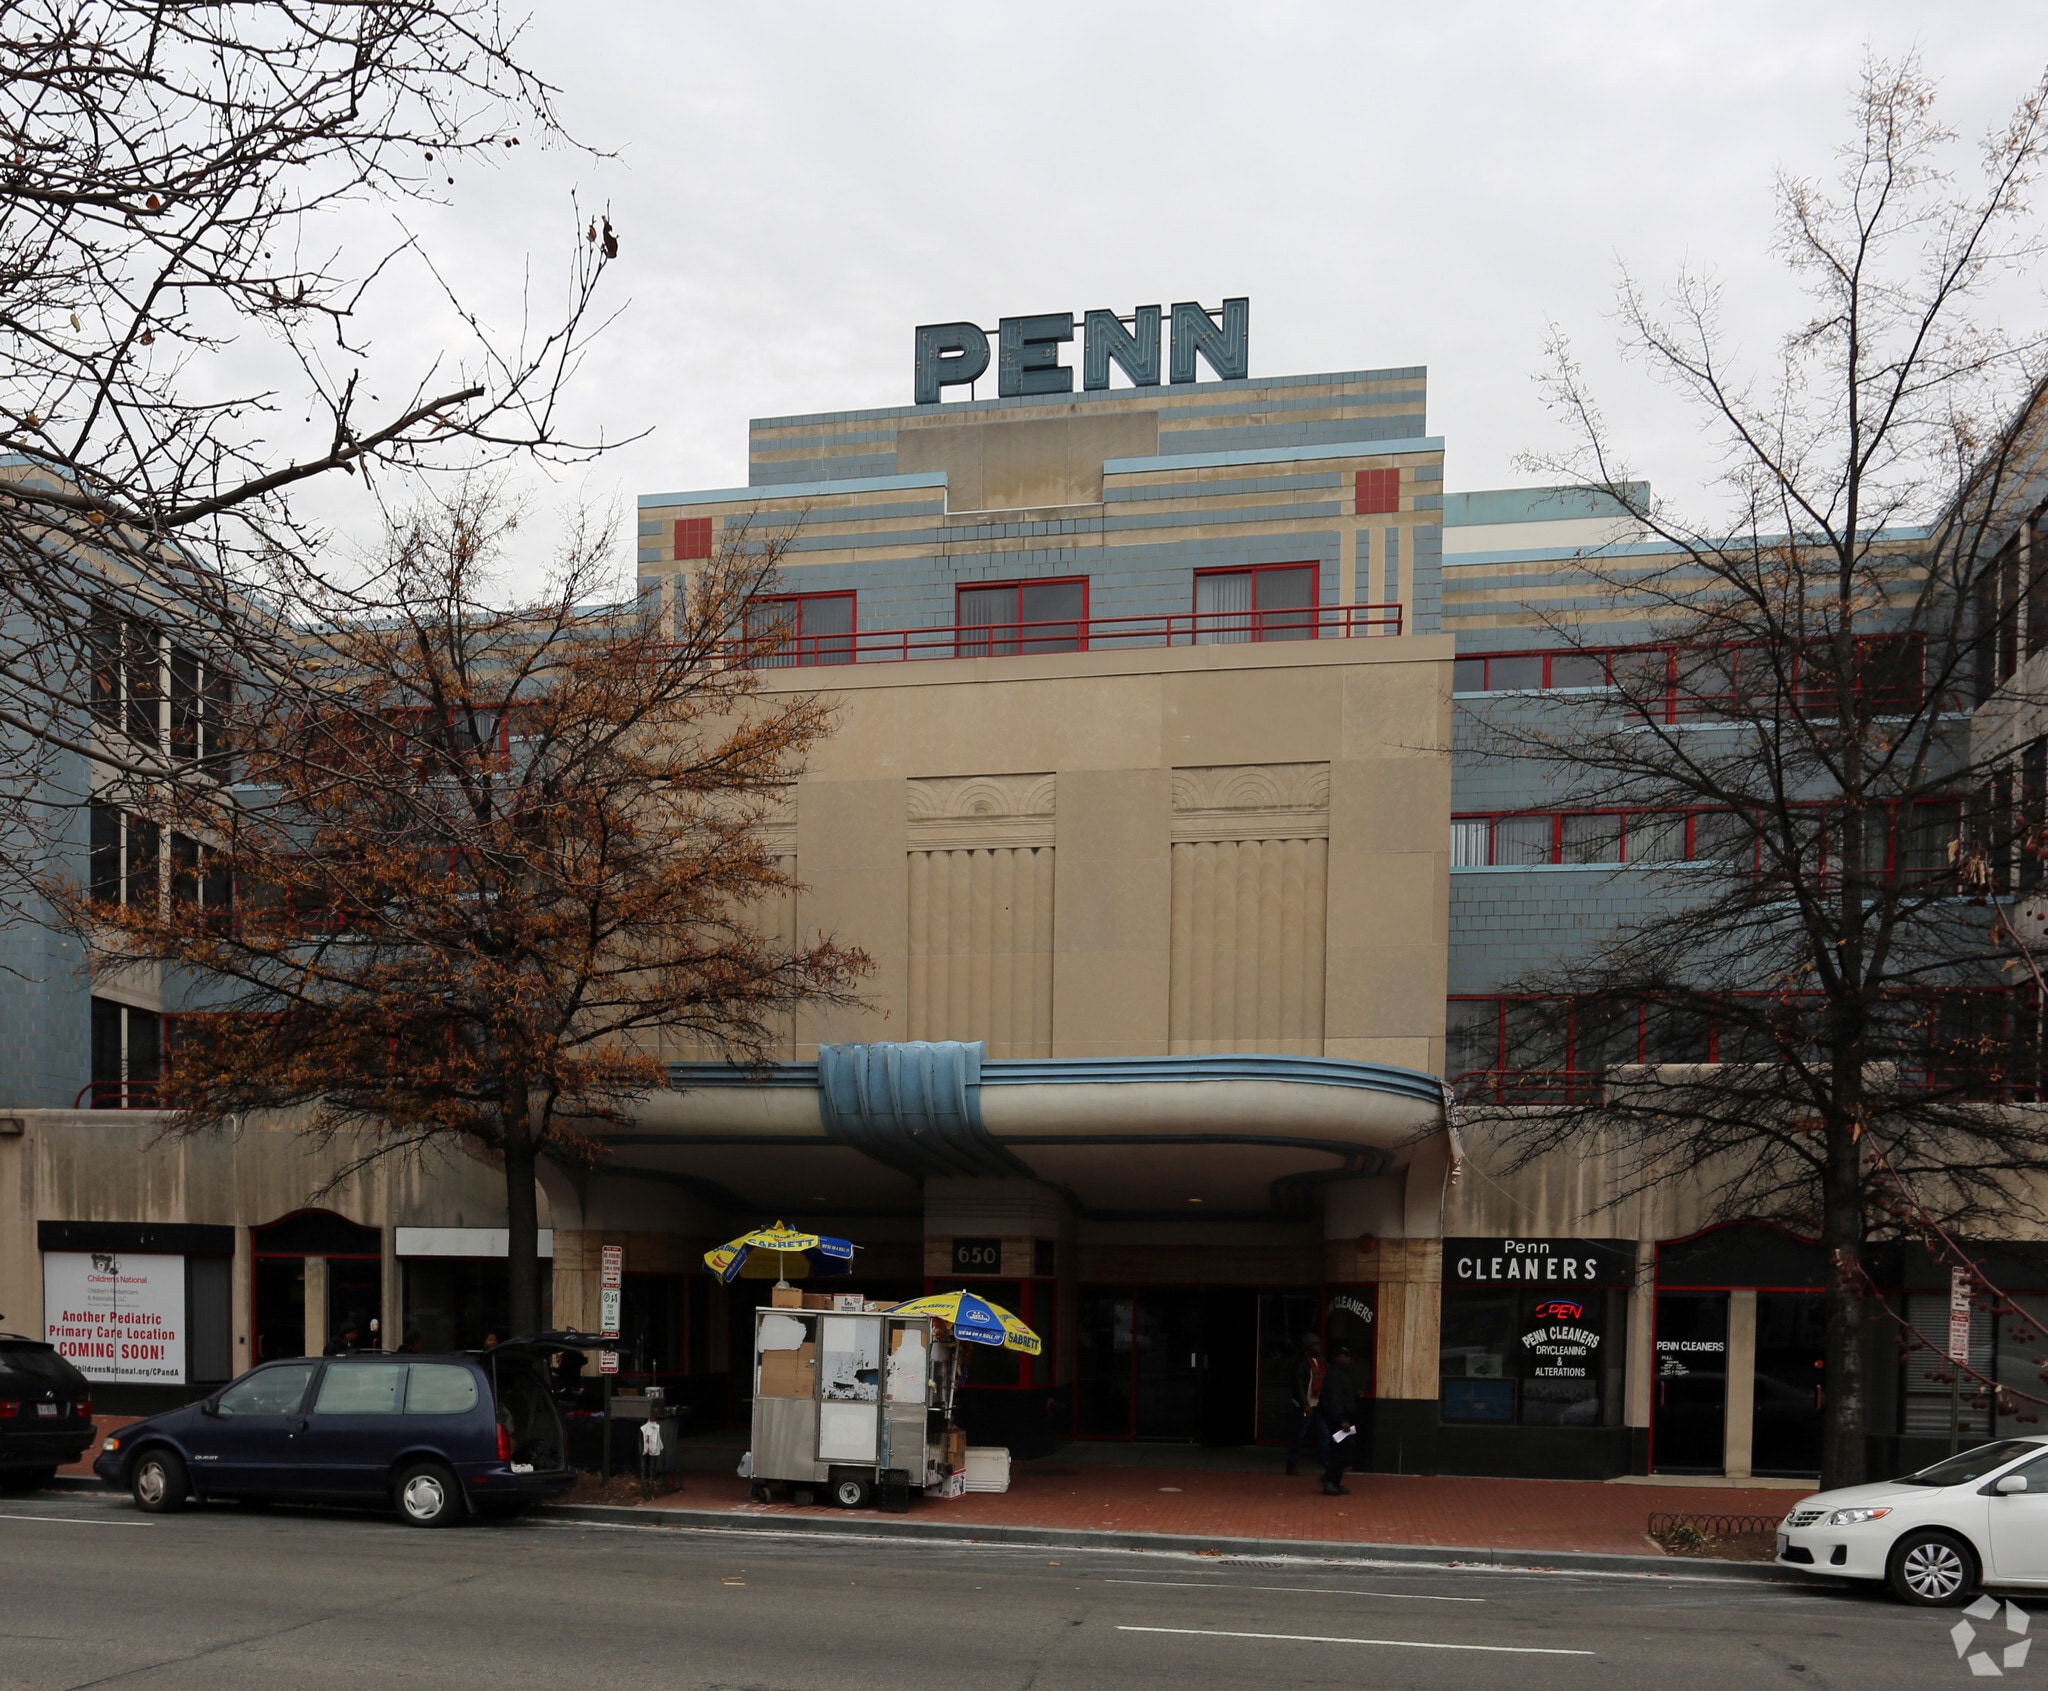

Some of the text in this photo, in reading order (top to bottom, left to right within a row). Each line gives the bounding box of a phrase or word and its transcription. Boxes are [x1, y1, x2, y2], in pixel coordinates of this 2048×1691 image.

[914, 297, 1249, 405] PENN
[958, 1246, 996, 1264] 650
[1504, 1240, 1550, 1254] Penn
[1457, 1257, 1597, 1280] CLEANERS
[87, 1274, 147, 1284] Childrens National
[1334, 1295, 1373, 1323] CLEANERS
[1535, 1303, 1583, 1319] OPEN
[62, 1310, 162, 1325] Another Pediatric
[49, 1325, 175, 1341] Primary Care Location
[1008, 1331, 1039, 1350] SABRETT
[1521, 1326, 1600, 1349] PENN CLEANERS
[59, 1342, 165, 1360] COMING SOON!
[1536, 1346, 1587, 1356] DRYCLEANING
[1656, 1341, 1724, 1352] PENN CLEANERS
[1556, 1356, 1563, 1366] &
[1535, 1367, 1586, 1377] ALTERATIONS
